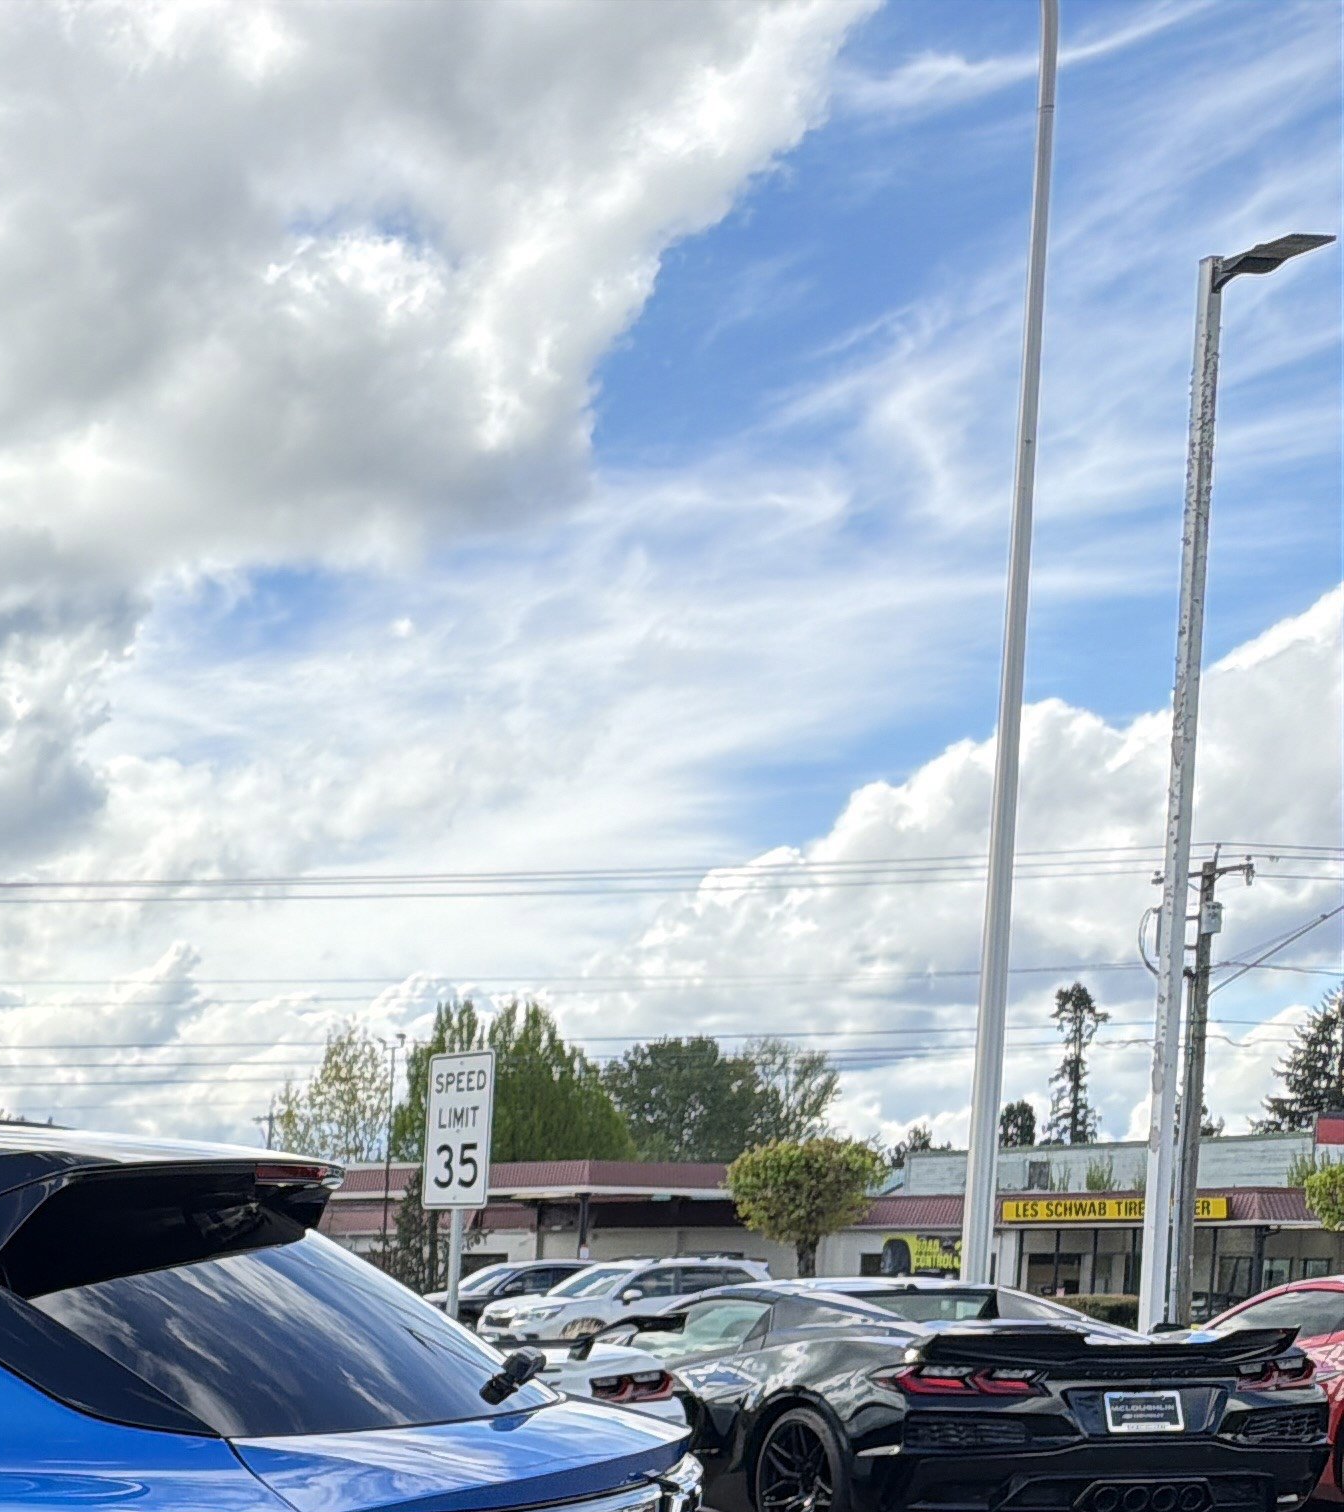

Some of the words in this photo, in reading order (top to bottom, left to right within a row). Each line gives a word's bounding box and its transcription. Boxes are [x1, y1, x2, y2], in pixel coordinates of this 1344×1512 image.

[435, 1069, 487, 1094] SPEED
[438, 1105, 479, 1129] LIMIT
[433, 1142, 478, 1189] 35
[1015, 1202, 1039, 1218] LES
[1045, 1201, 1107, 1217] SCHWAB
[1116, 1201, 1145, 1217] TIRE
